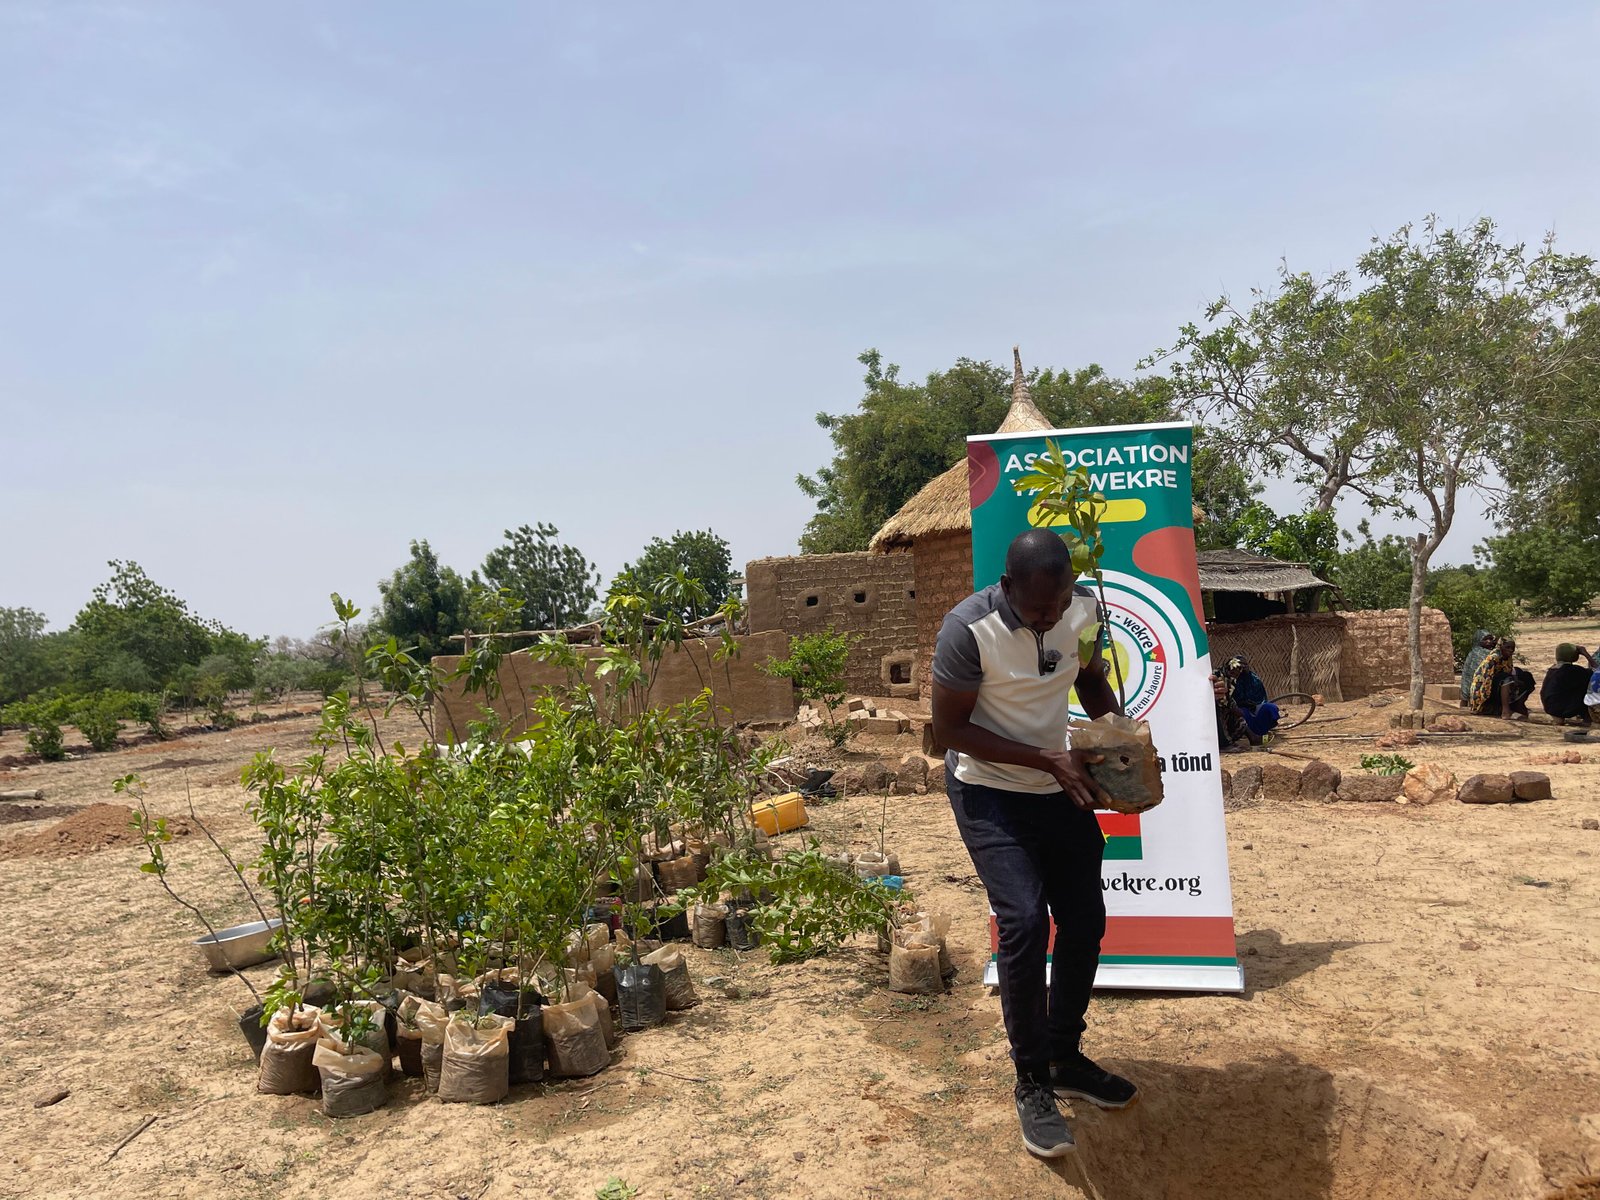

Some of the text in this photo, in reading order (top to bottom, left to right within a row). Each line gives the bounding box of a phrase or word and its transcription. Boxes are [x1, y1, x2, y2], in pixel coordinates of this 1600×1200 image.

[1088, 469, 1178, 491] WEKRE
[1122, 616, 1153, 649] wekre
[1125, 665, 1162, 719] ãnem-baoore
[1171, 752, 1212, 772] tõnd
